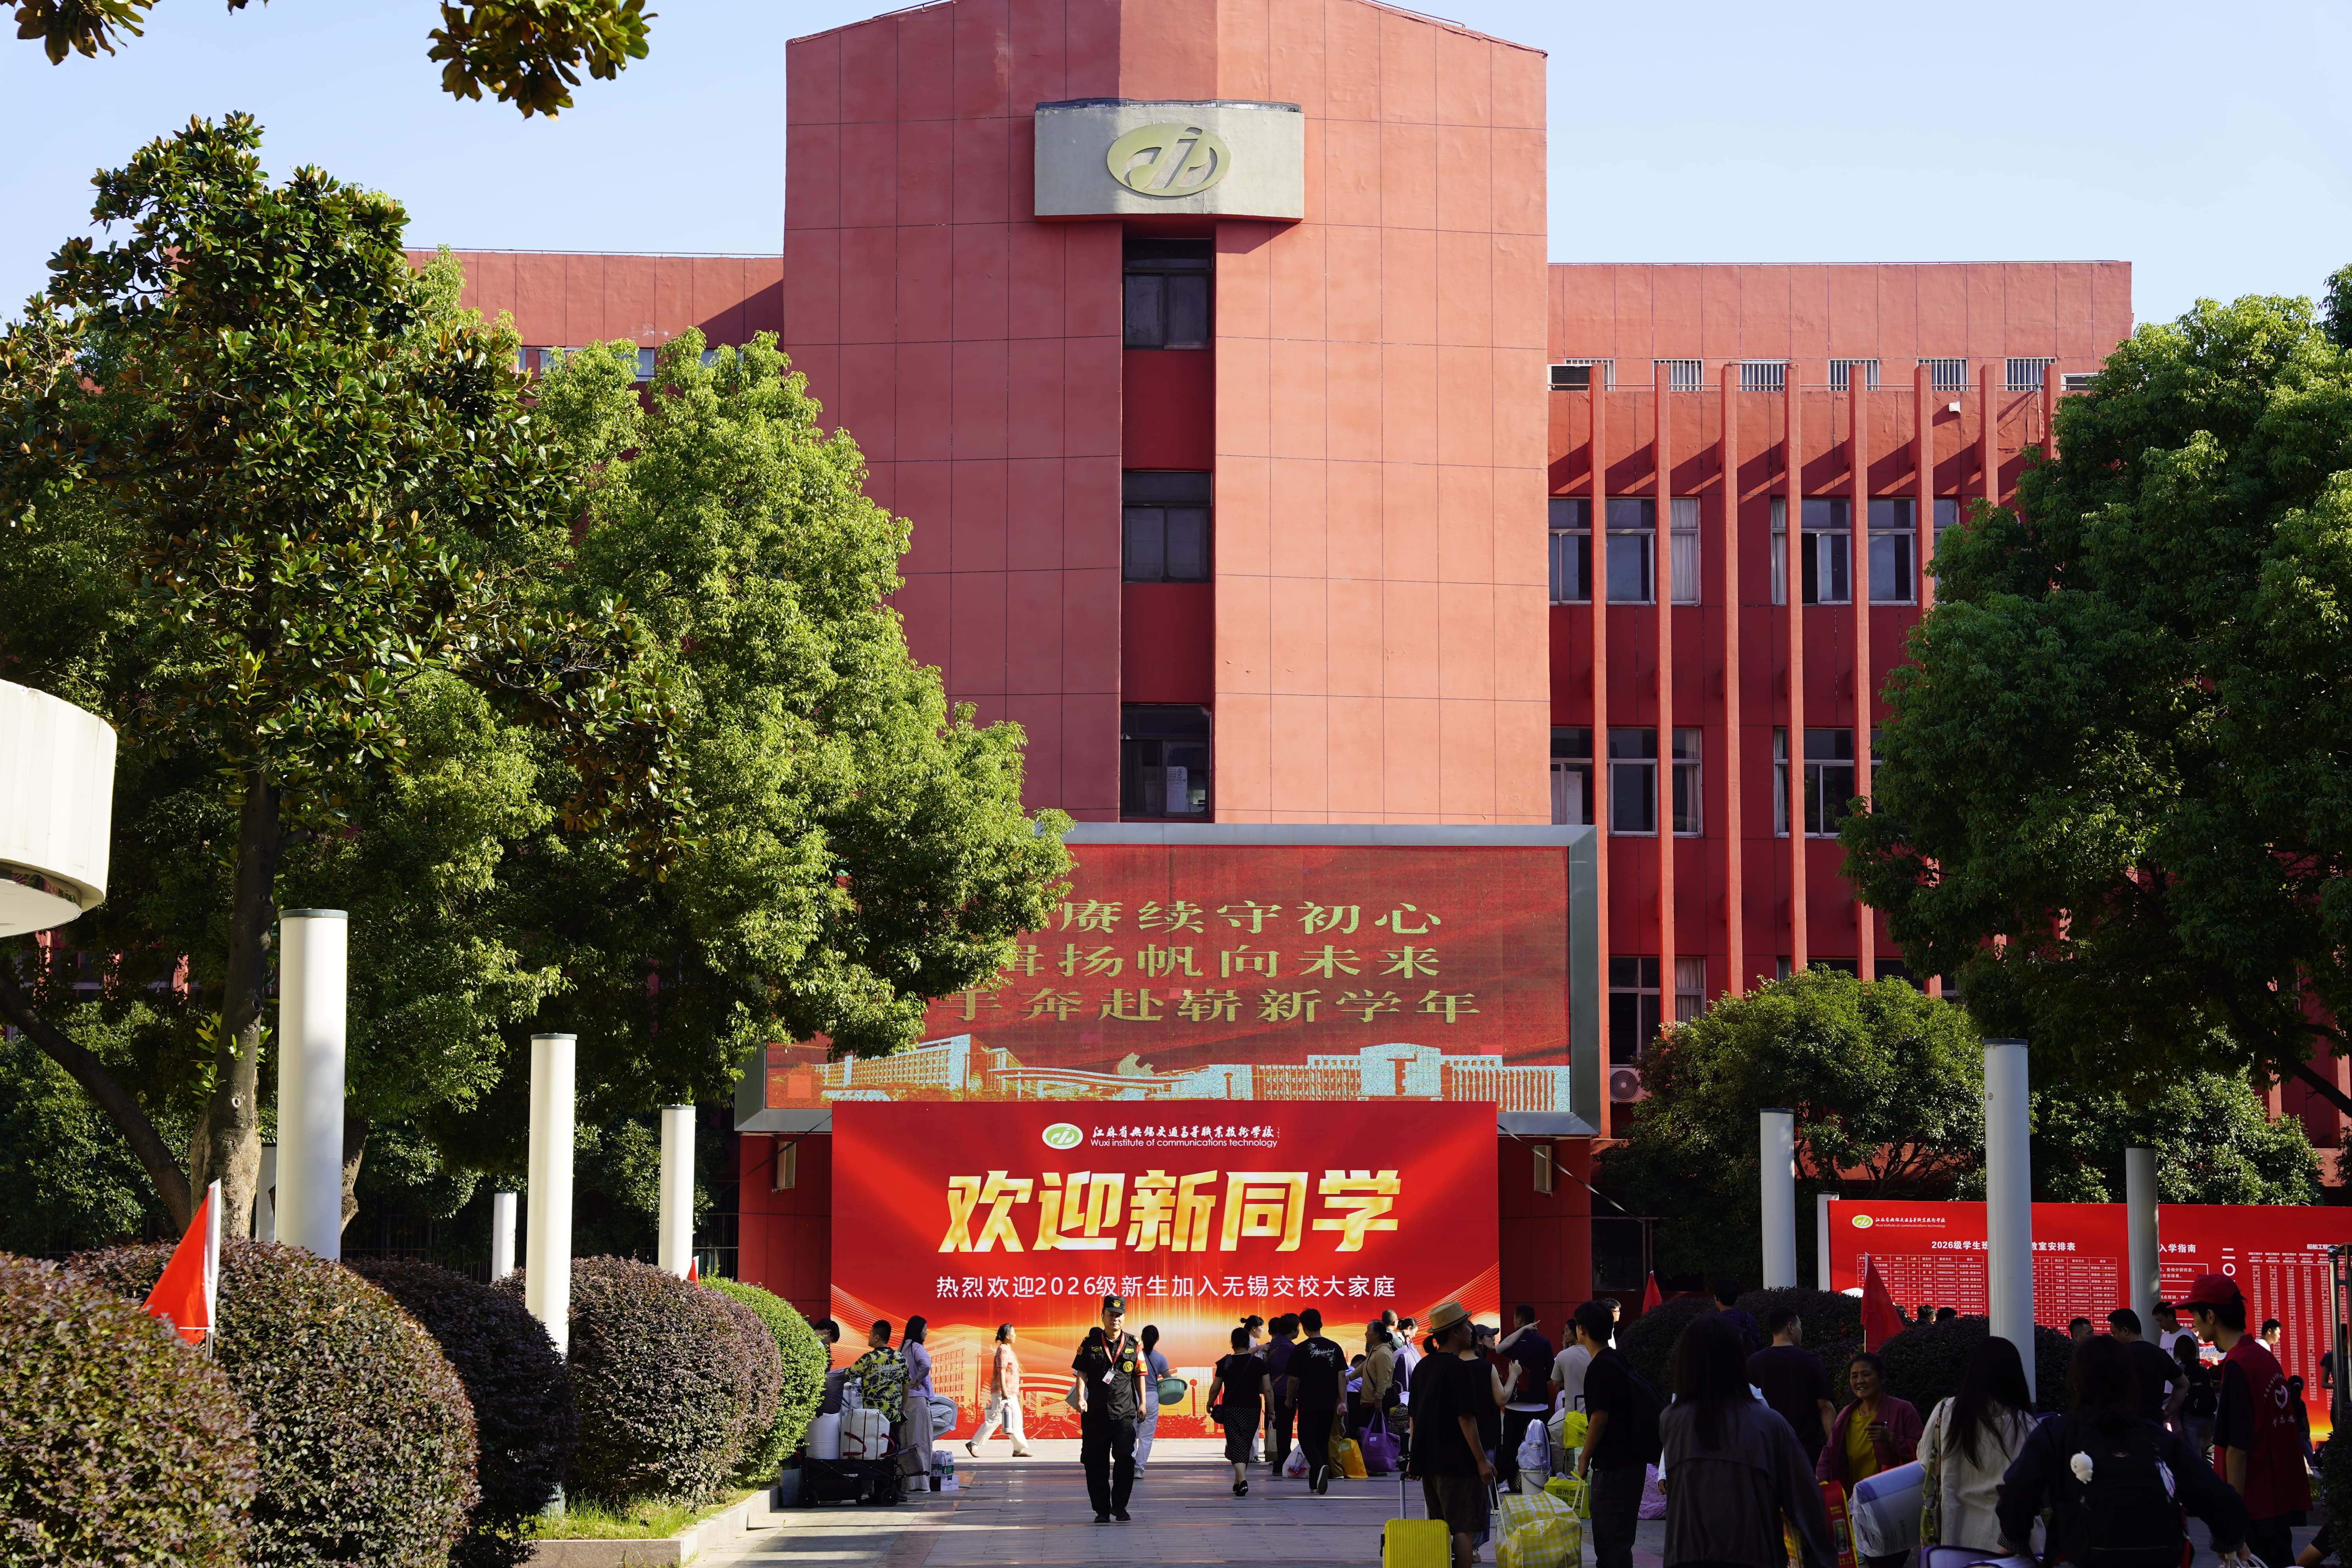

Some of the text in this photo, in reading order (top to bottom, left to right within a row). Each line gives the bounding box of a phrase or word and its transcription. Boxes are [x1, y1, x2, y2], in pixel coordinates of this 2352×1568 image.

[1146, 1138, 1155, 1146] of
[1229, 1138, 1278, 1148] technology
[938, 1170, 1401, 1253] 欢迎新同学
[2159, 1243, 2196, 1253] 入学指南
[936, 1275, 1396, 1298] 热烈欢迎2026级新生加入无锡交校大家庭
